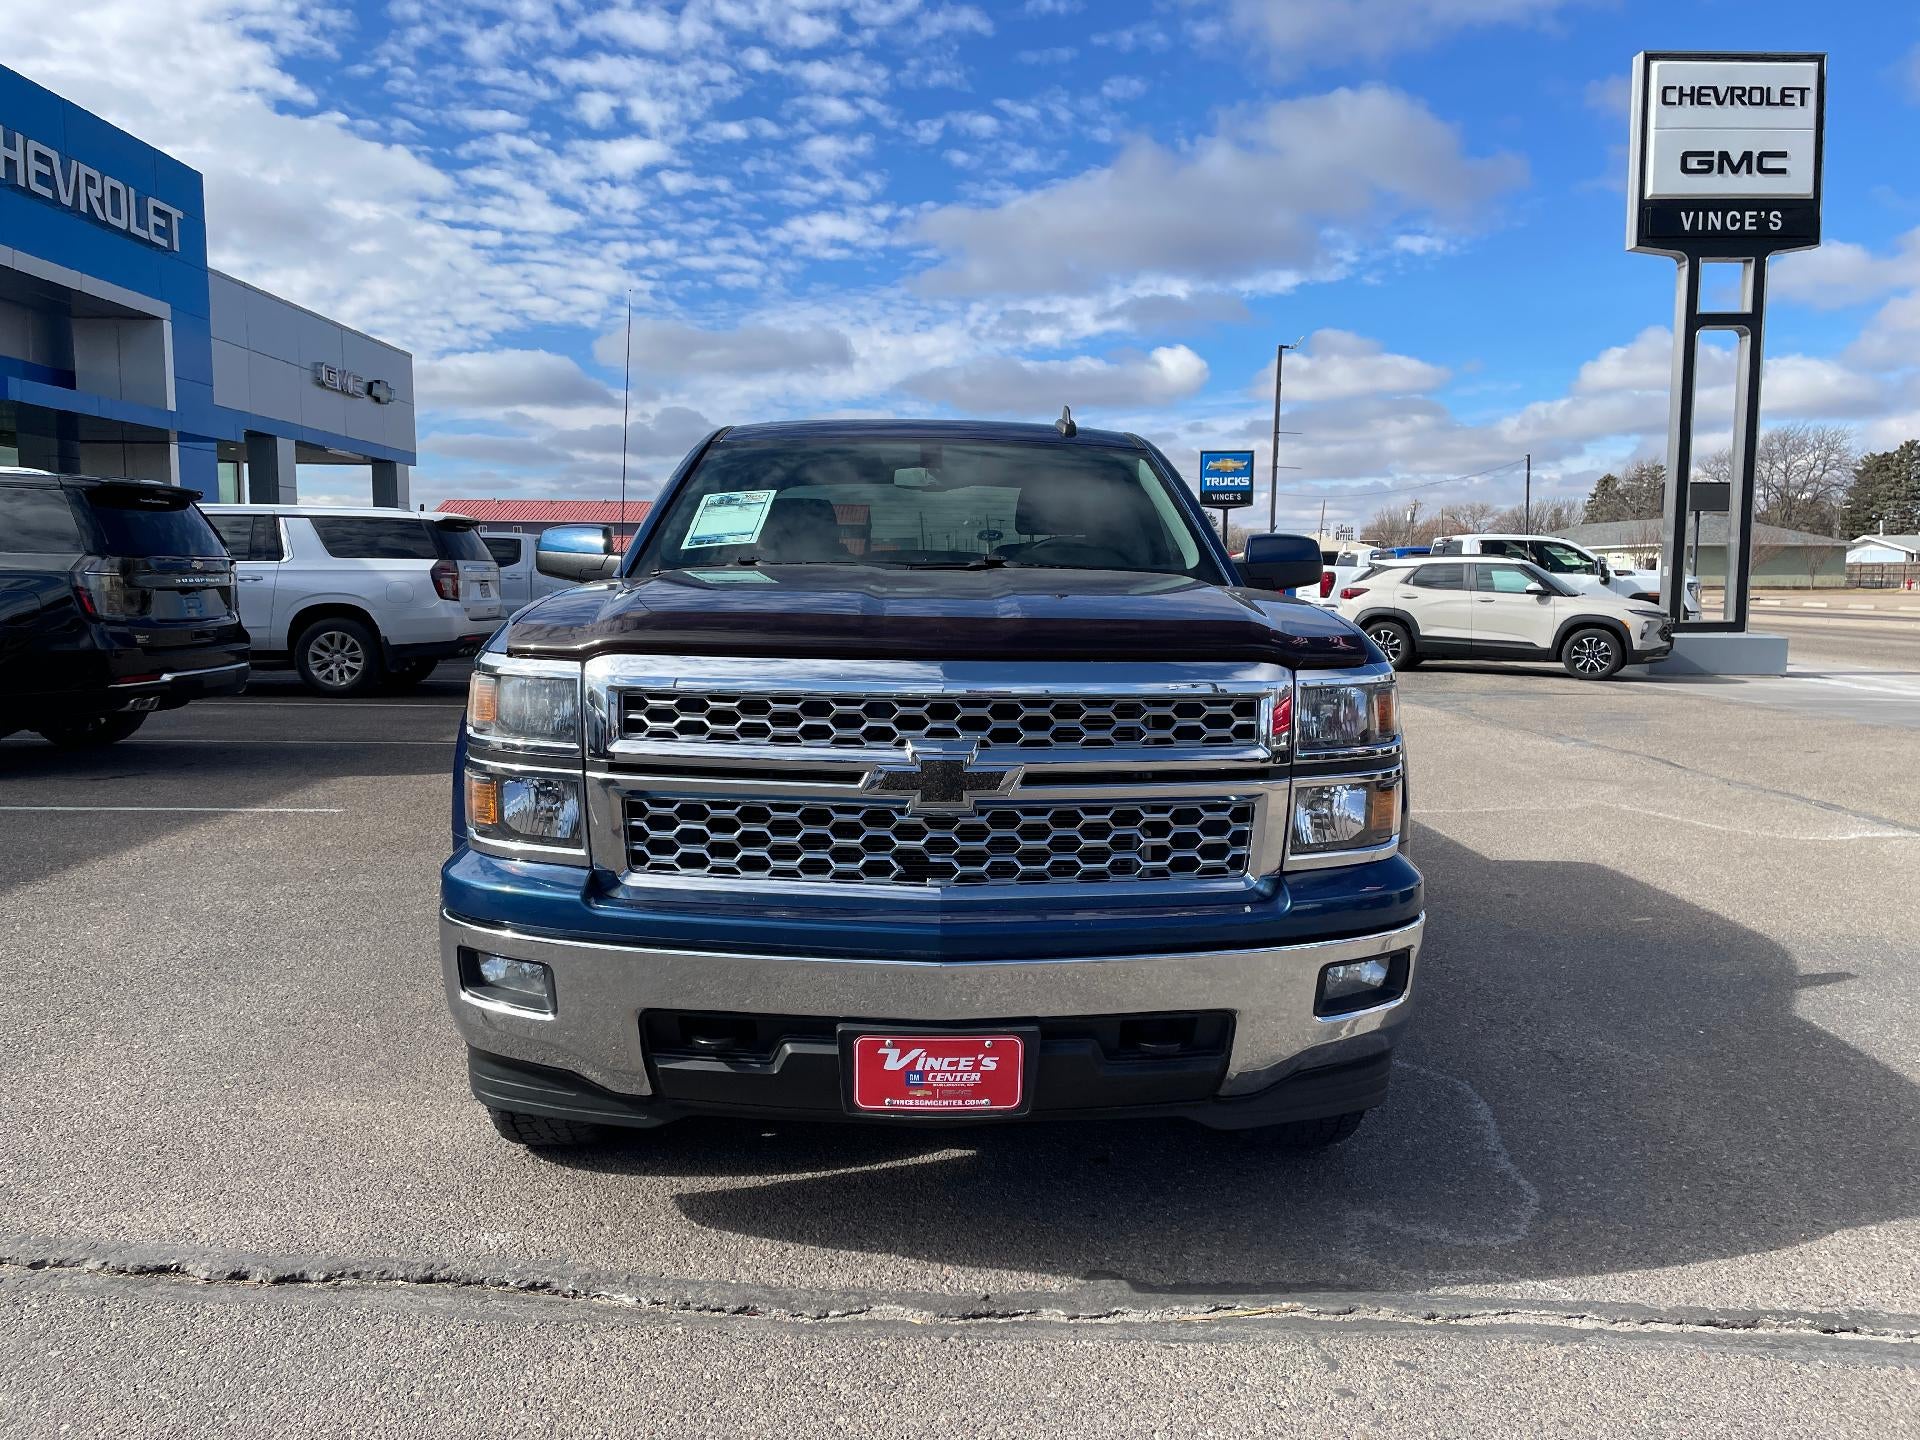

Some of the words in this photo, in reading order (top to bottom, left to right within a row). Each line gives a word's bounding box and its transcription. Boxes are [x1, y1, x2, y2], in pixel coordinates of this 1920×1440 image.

[1661, 86, 1811, 107] CHEVROLET
[1680, 150, 1788, 175] GMC
[1680, 211, 1783, 231] VINCE'S
[321, 363, 366, 399] GMC
[1205, 477, 1250, 486] TRUCKS
[927, 1072, 982, 1082] CENTER
